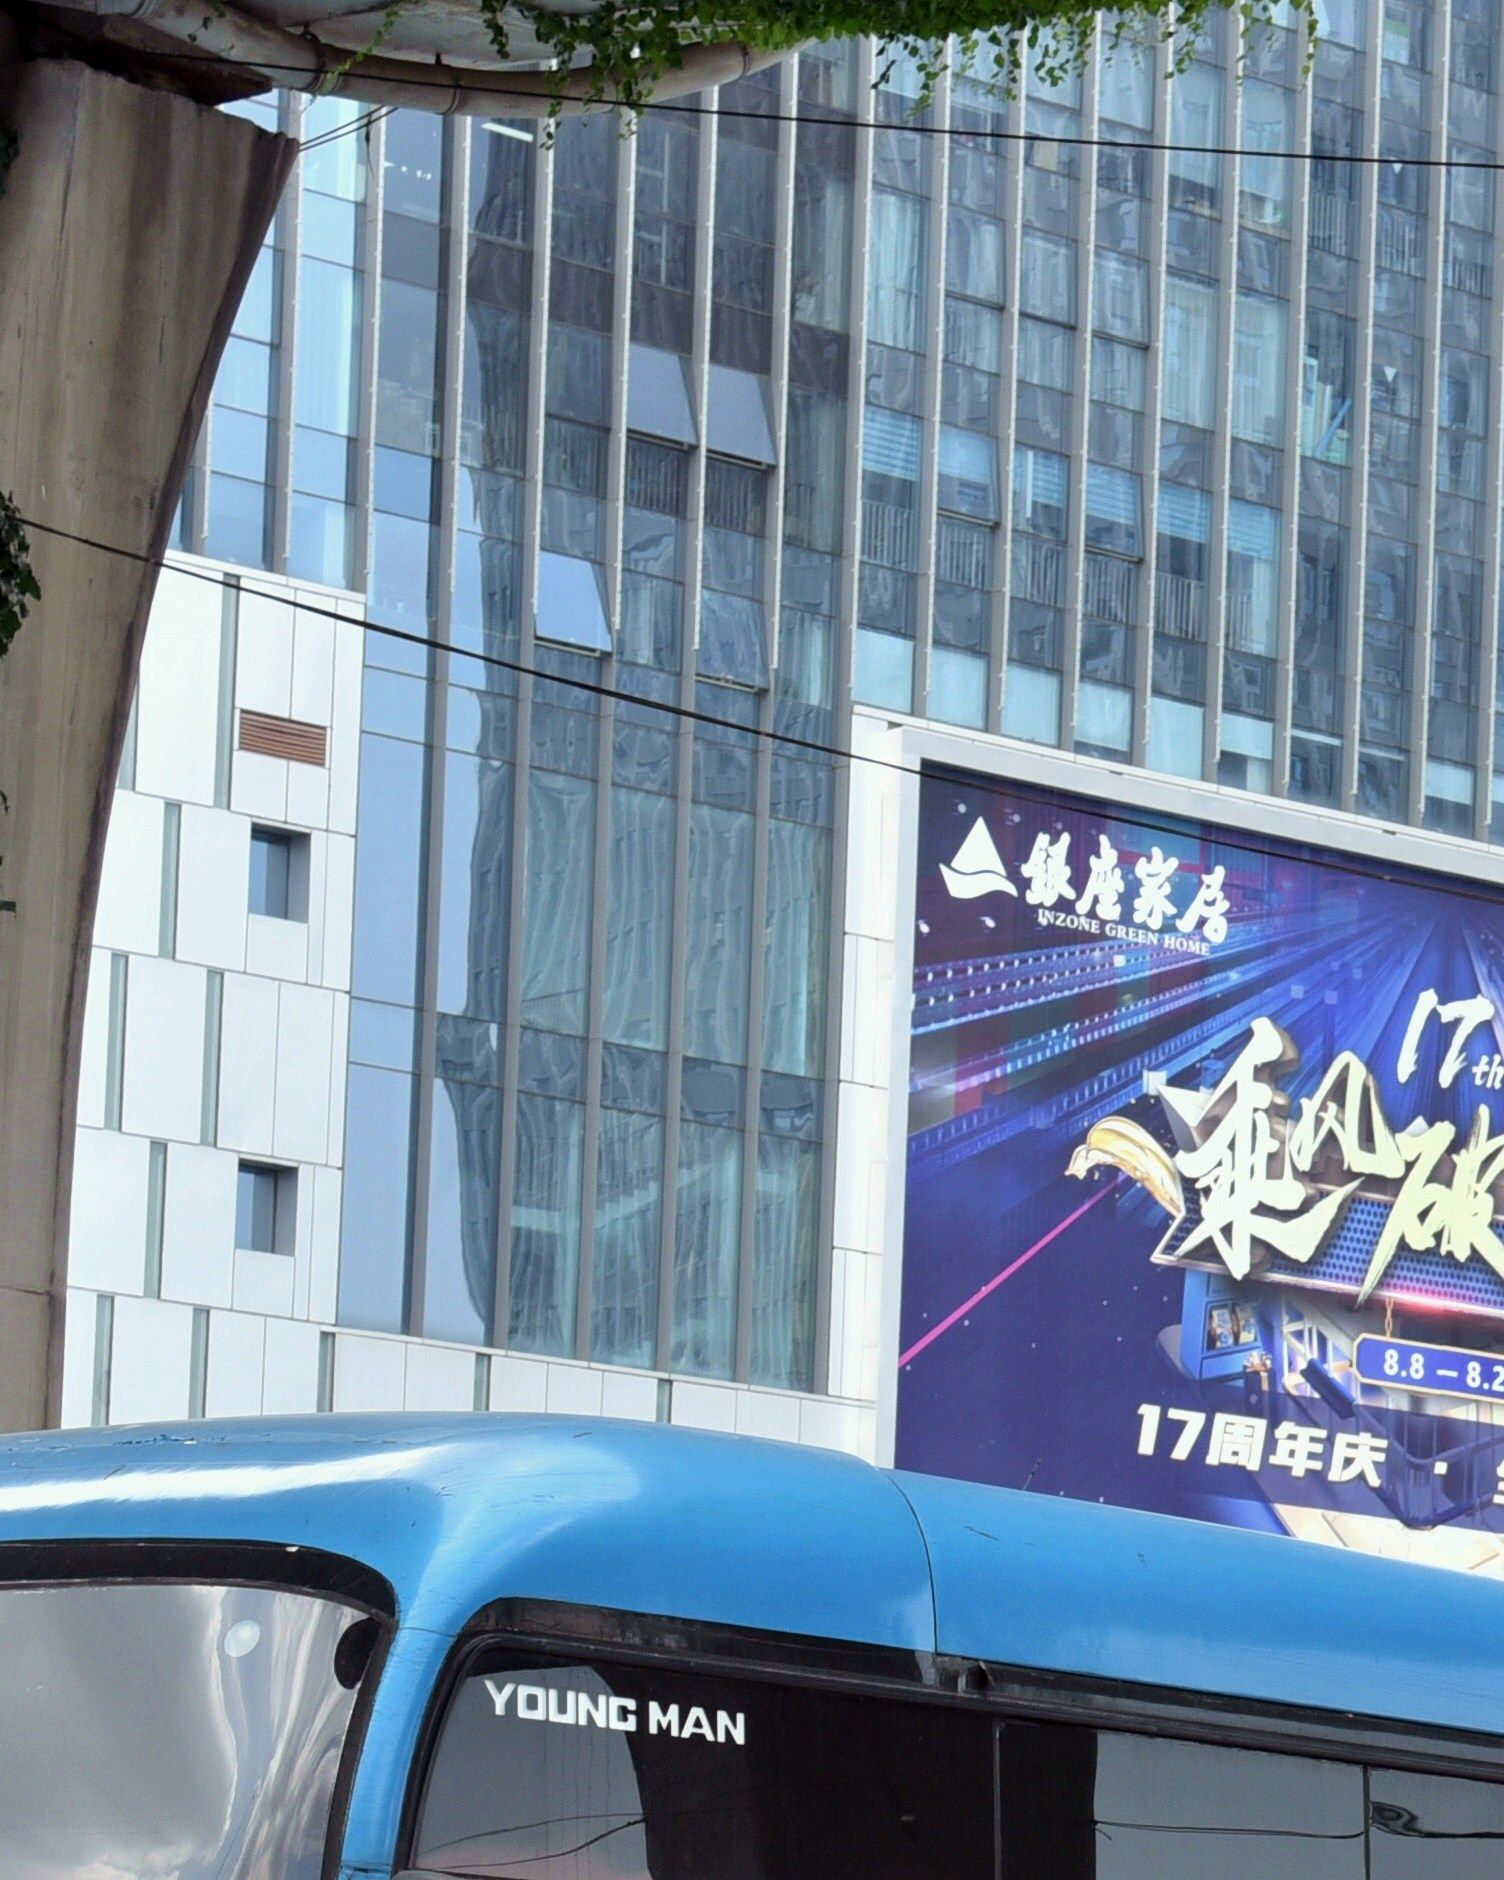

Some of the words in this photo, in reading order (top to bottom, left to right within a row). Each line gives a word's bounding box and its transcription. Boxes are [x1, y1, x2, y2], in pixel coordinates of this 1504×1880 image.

[1037, 908, 1101, 934] INZONE
[1105, 922, 1159, 946] GREEN
[1163, 931, 1212, 956] HOME
[1382, 1347, 1426, 1380] 8.8
[1135, 1404, 1389, 1488] 17周年庆
[484, 1679, 638, 1733] YOUNG
[648, 1700, 746, 1746] MAN
